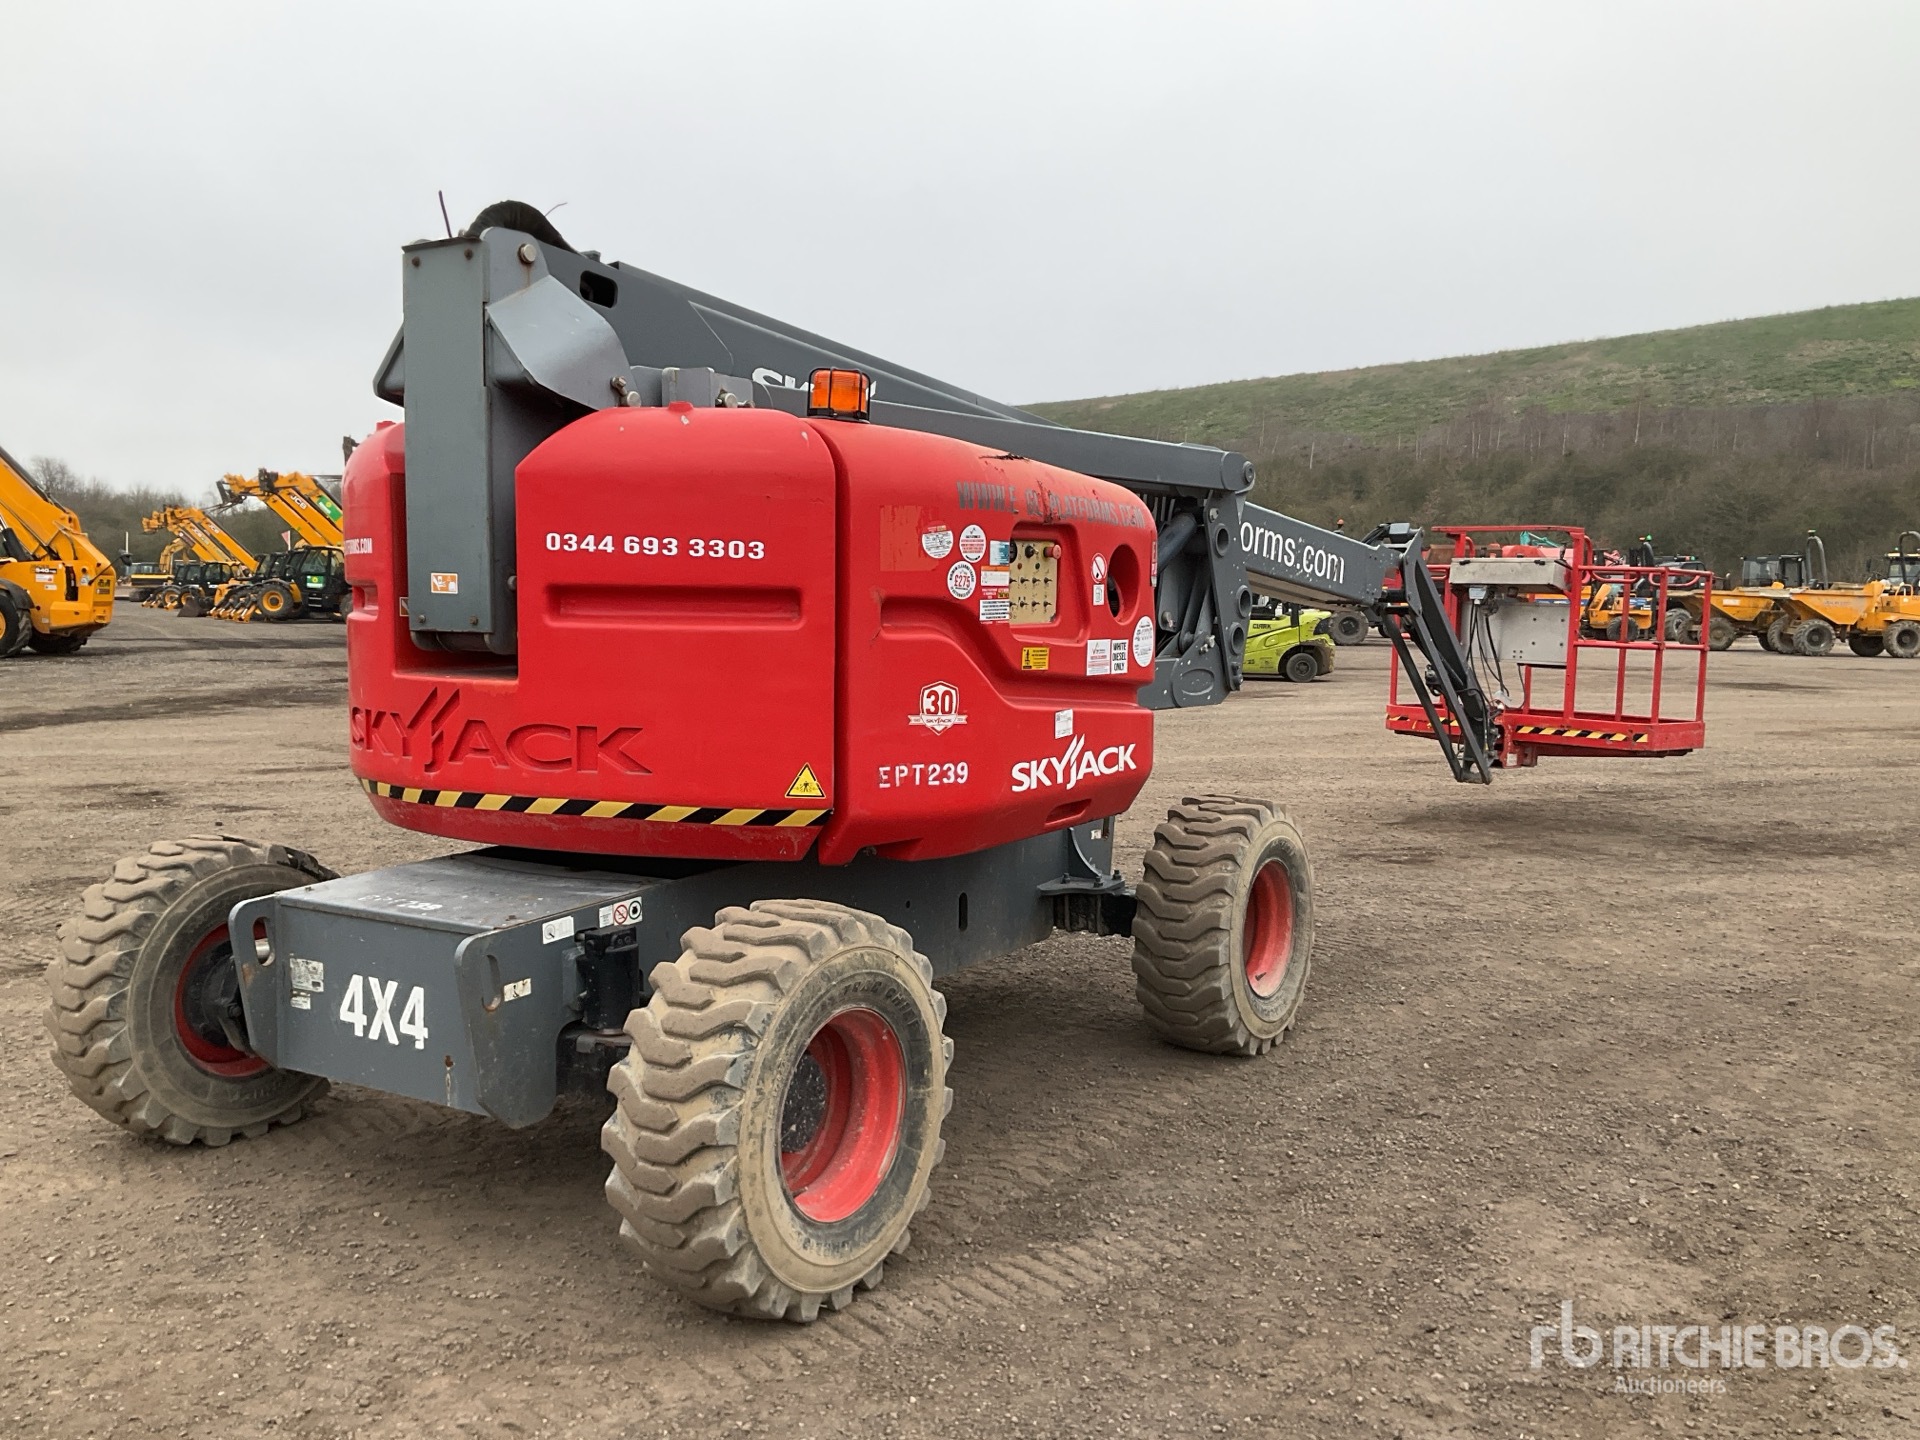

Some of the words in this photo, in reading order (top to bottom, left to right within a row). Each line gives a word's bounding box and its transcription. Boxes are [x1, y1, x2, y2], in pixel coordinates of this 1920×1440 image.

[289, 494, 307, 510] JCB
[546, 532, 615, 553] 0344
[624, 536, 679, 556] 693
[688, 538, 766, 560] 3303
[954, 574, 971, 588] £275
[1112, 642, 1127, 651] WHITE
[1112, 652, 1126, 661] DIESEL
[1113, 662, 1125, 671] ONLY
[925, 689, 953, 715] 30
[350, 686, 654, 775] SKYJACK
[878, 761, 969, 789] EPT239
[1011, 733, 1137, 792] SKYJACK
[338, 973, 429, 1050] 4X4
